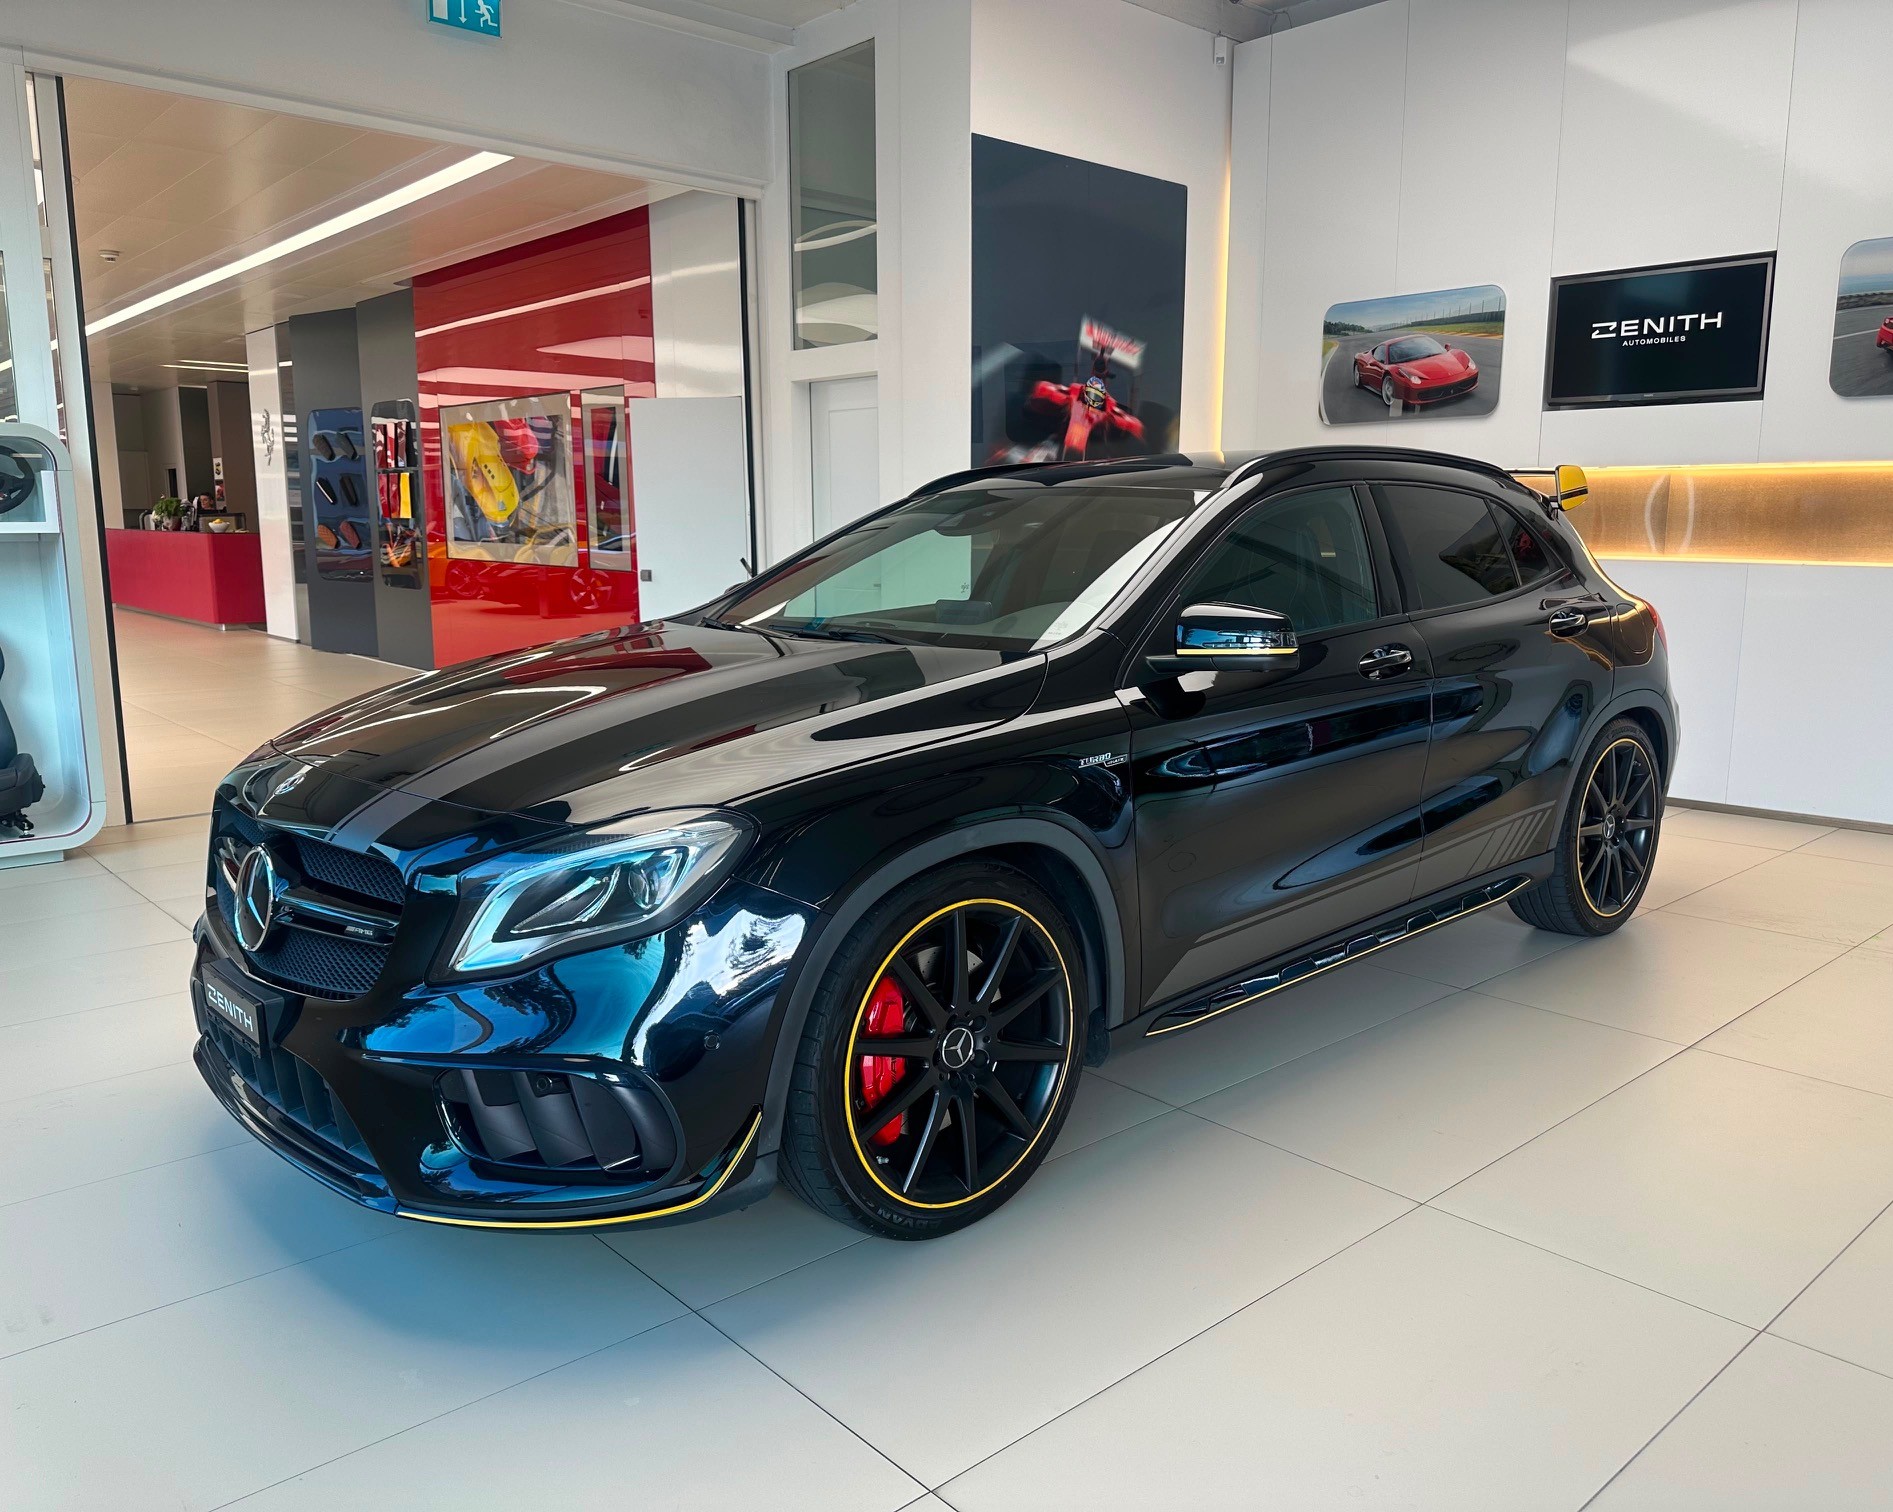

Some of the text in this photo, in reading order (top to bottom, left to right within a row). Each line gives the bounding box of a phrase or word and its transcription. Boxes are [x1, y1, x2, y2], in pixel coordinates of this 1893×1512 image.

[1591, 311, 1722, 339] ZENITH
[1622, 335, 1686, 347] AUTOMOBILES
[1079, 752, 1112, 766] TURBO
[206, 983, 254, 1032] ZENITH
